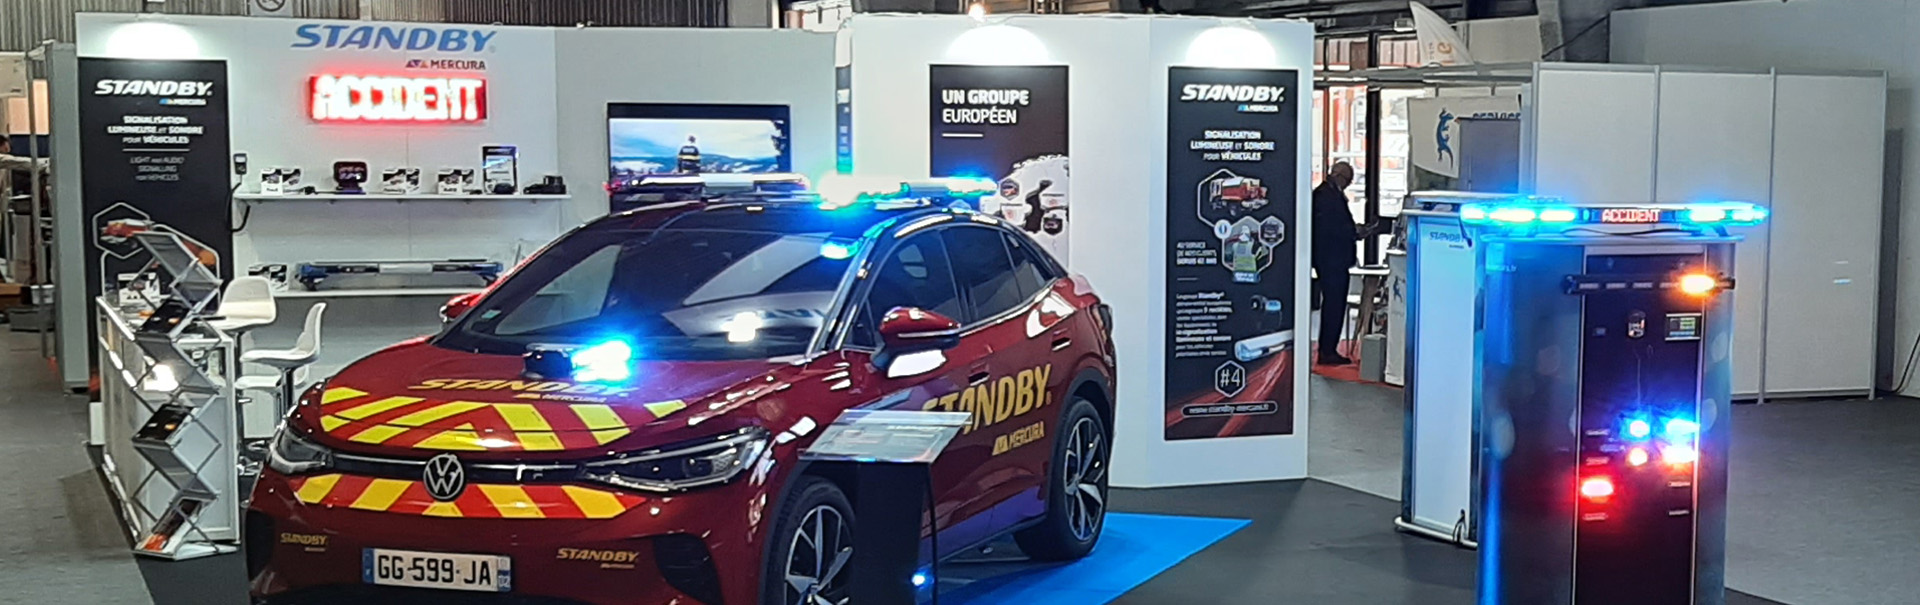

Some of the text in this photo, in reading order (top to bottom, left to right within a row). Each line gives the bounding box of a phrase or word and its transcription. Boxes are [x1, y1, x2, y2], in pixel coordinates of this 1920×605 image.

[290, 24, 497, 52] STANDBY
[430, 59, 486, 70] MERCURA
[95, 79, 213, 96] STANDBY
[1181, 84, 1284, 102] STANDBY
[312, 75, 482, 120] ACCIDENT
[941, 89, 1029, 105] UN GROUPE
[123, 115, 188, 124] SIGNALISATION
[942, 106, 1017, 124] EUROPÉEN
[107, 125, 157, 134] LUMINEUSE
[168, 126, 204, 134] SONORE
[1204, 130, 1261, 139] SIGNALISATION
[1190, 140, 1234, 149] LUMINEUSE
[1243, 141, 1275, 150] SONORE
[1602, 208, 1661, 223] ACCIDENT
[1220, 368, 1241, 387] #4
[556, 547, 640, 562] STANDBY
[378, 555, 491, 585] GG-599-JA
